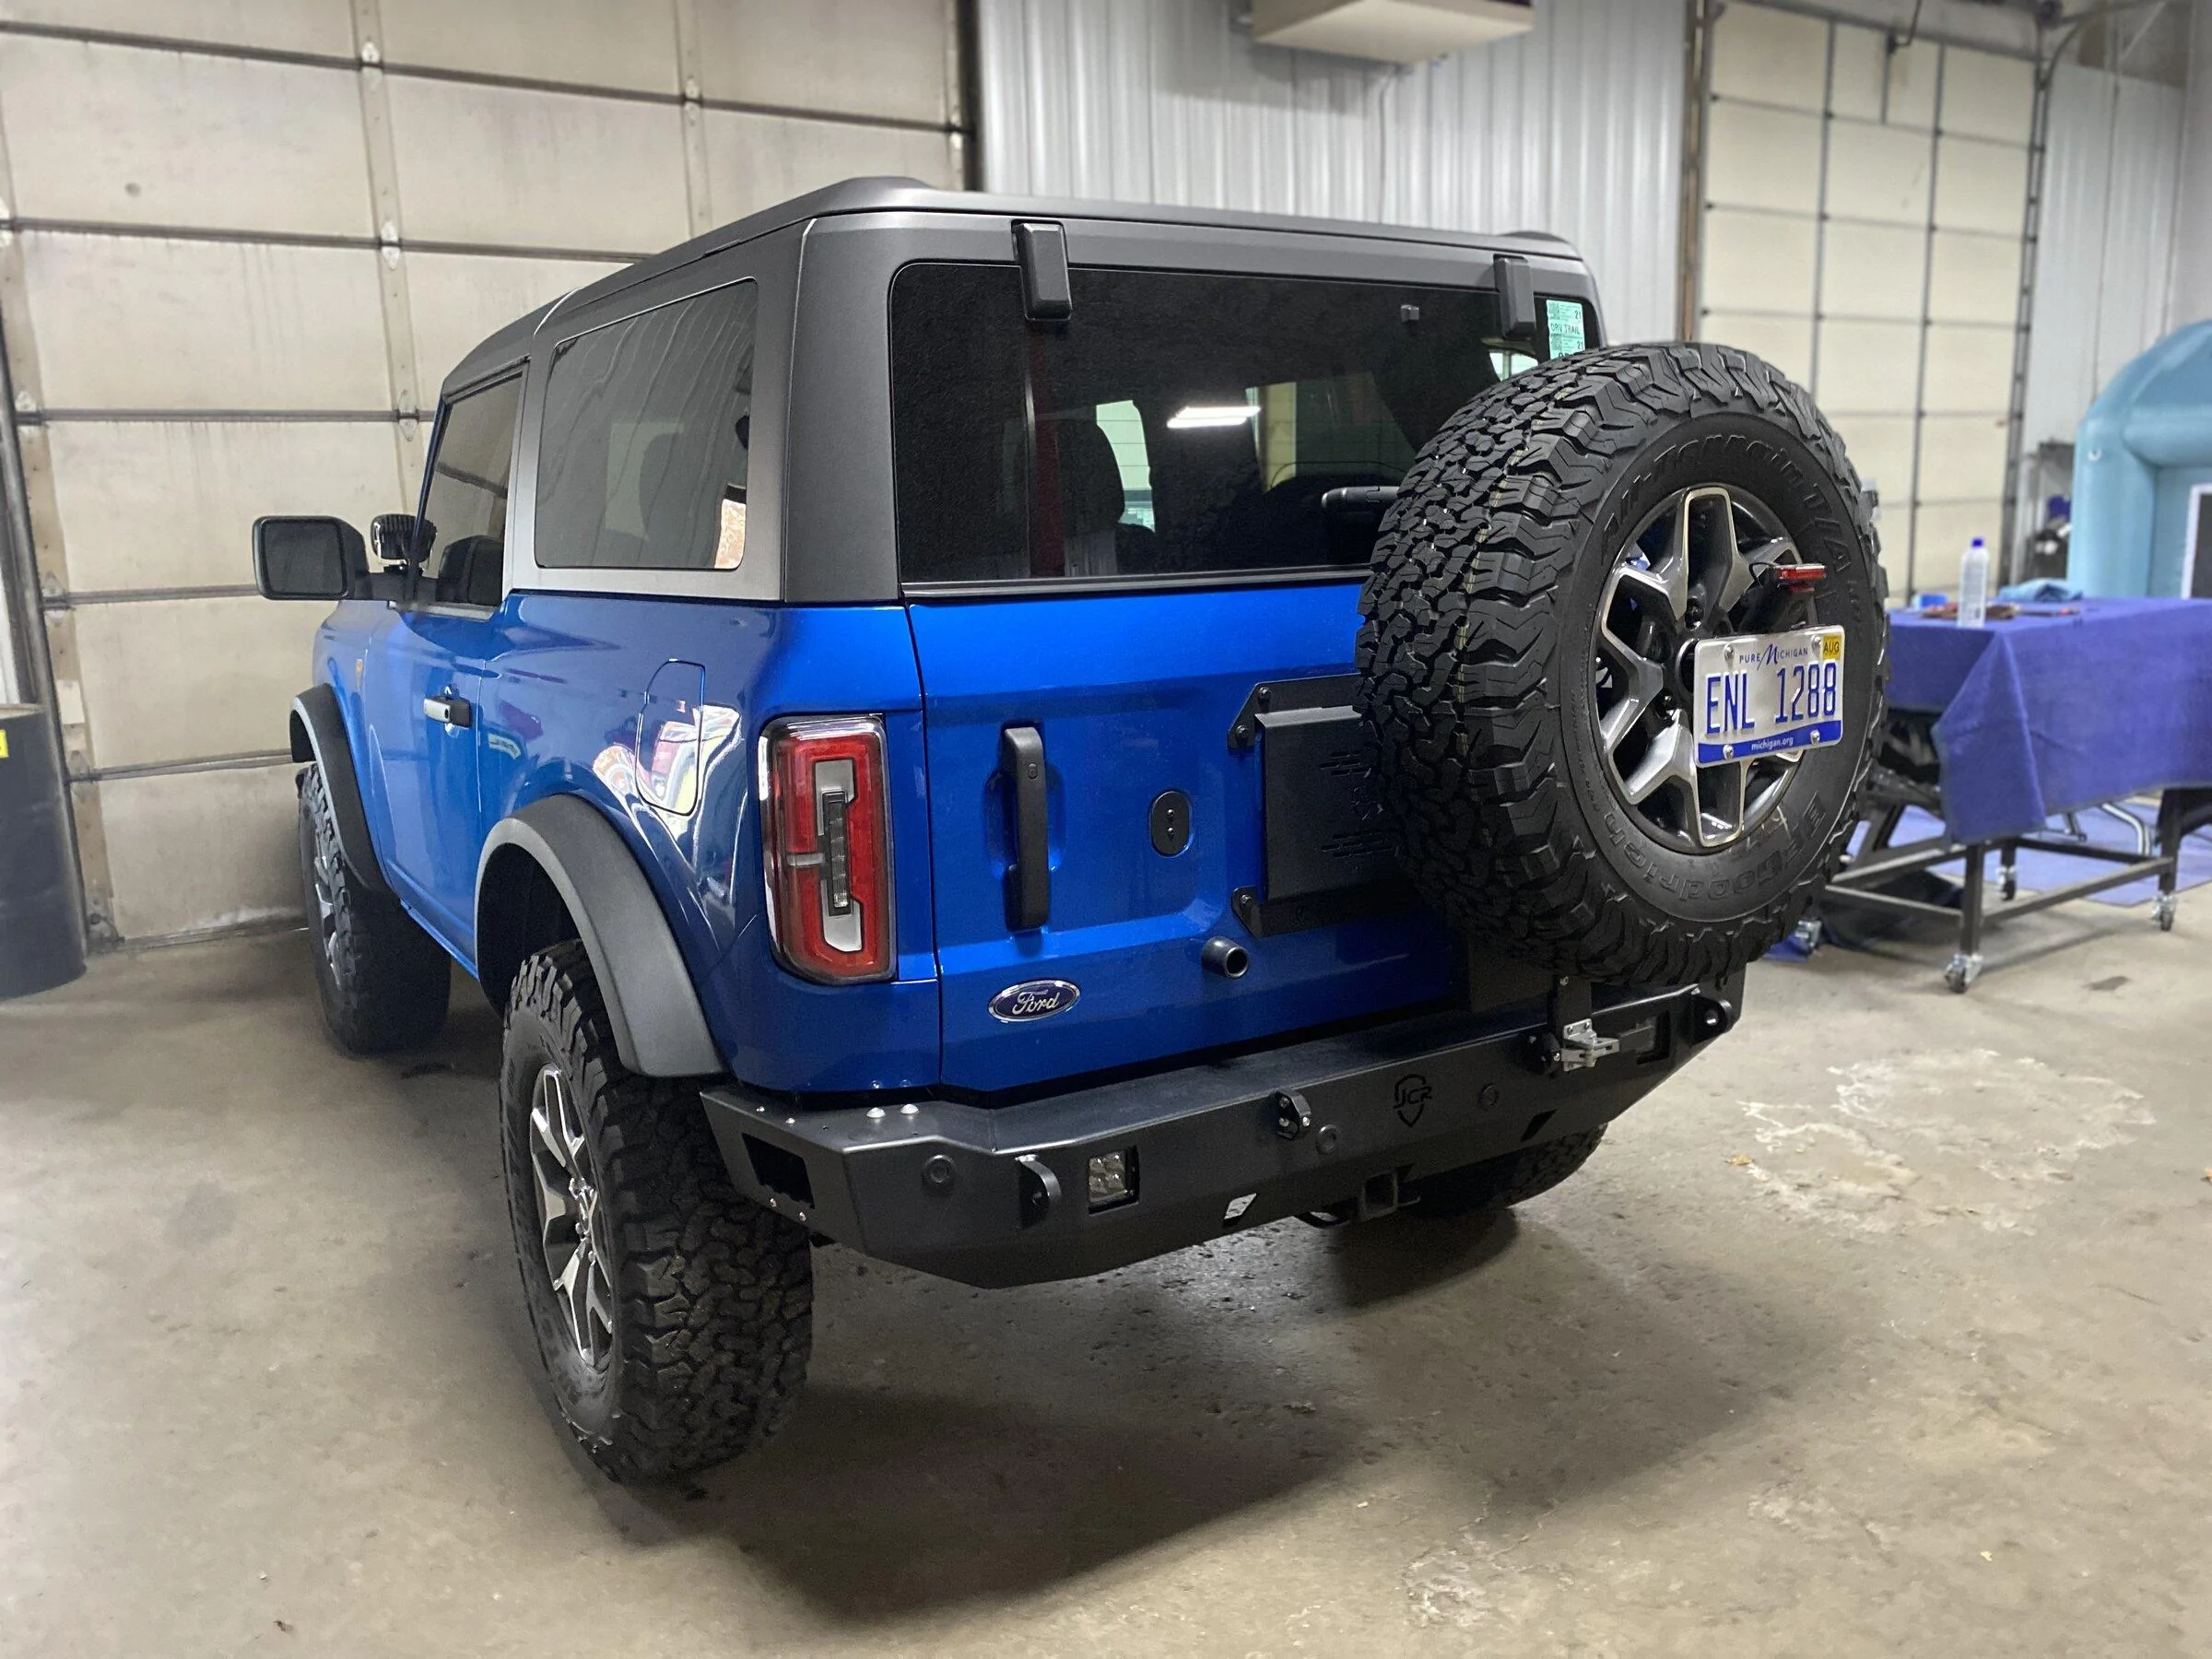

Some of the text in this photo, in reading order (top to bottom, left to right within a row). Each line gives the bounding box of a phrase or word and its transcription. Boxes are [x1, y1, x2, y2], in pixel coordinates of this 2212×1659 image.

[1564, 324, 1581, 335] TRAIL
[1823, 641, 1840, 653] AUG
[1739, 653, 1760, 664] PURE
[1706, 661, 1837, 735] ENL 1288
[1751, 736, 1794, 751] michigan.org
[1012, 989, 1060, 1015] Ford
